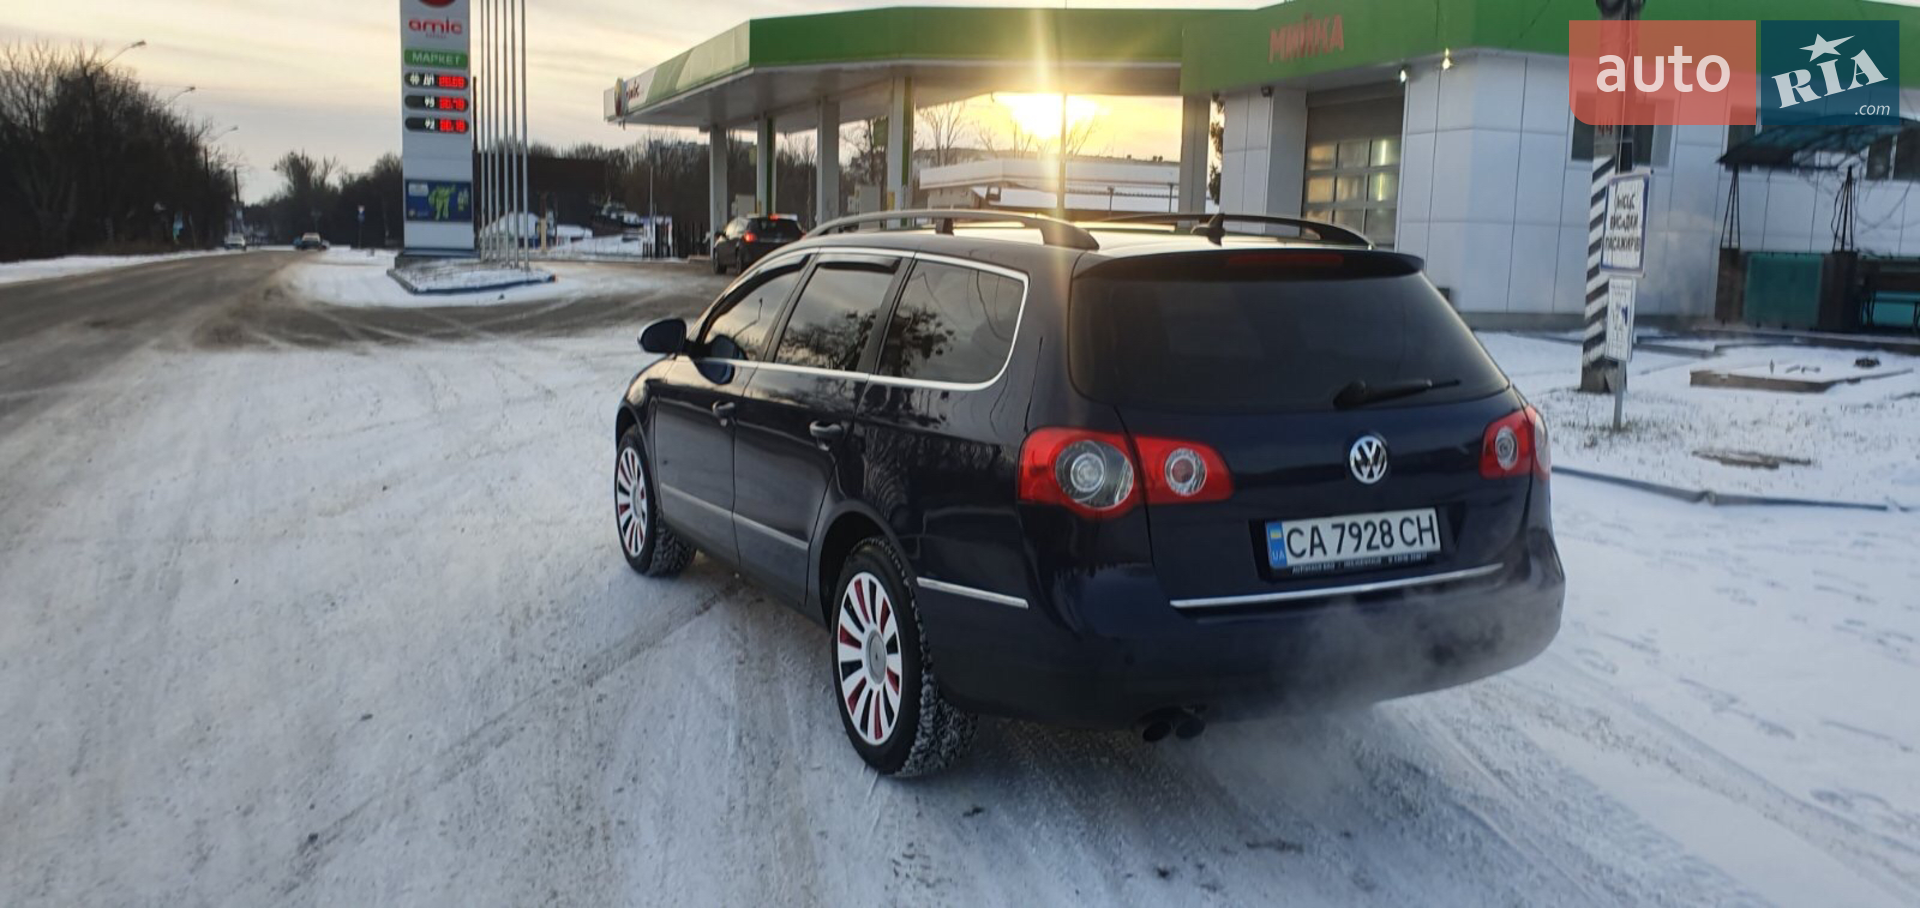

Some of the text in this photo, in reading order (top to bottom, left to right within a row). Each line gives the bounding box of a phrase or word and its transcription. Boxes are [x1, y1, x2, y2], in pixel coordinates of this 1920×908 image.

[408, 17, 462, 35] amic
[1287, 514, 1437, 558] CA 7928 CH
[1271, 551, 1286, 562] UA
